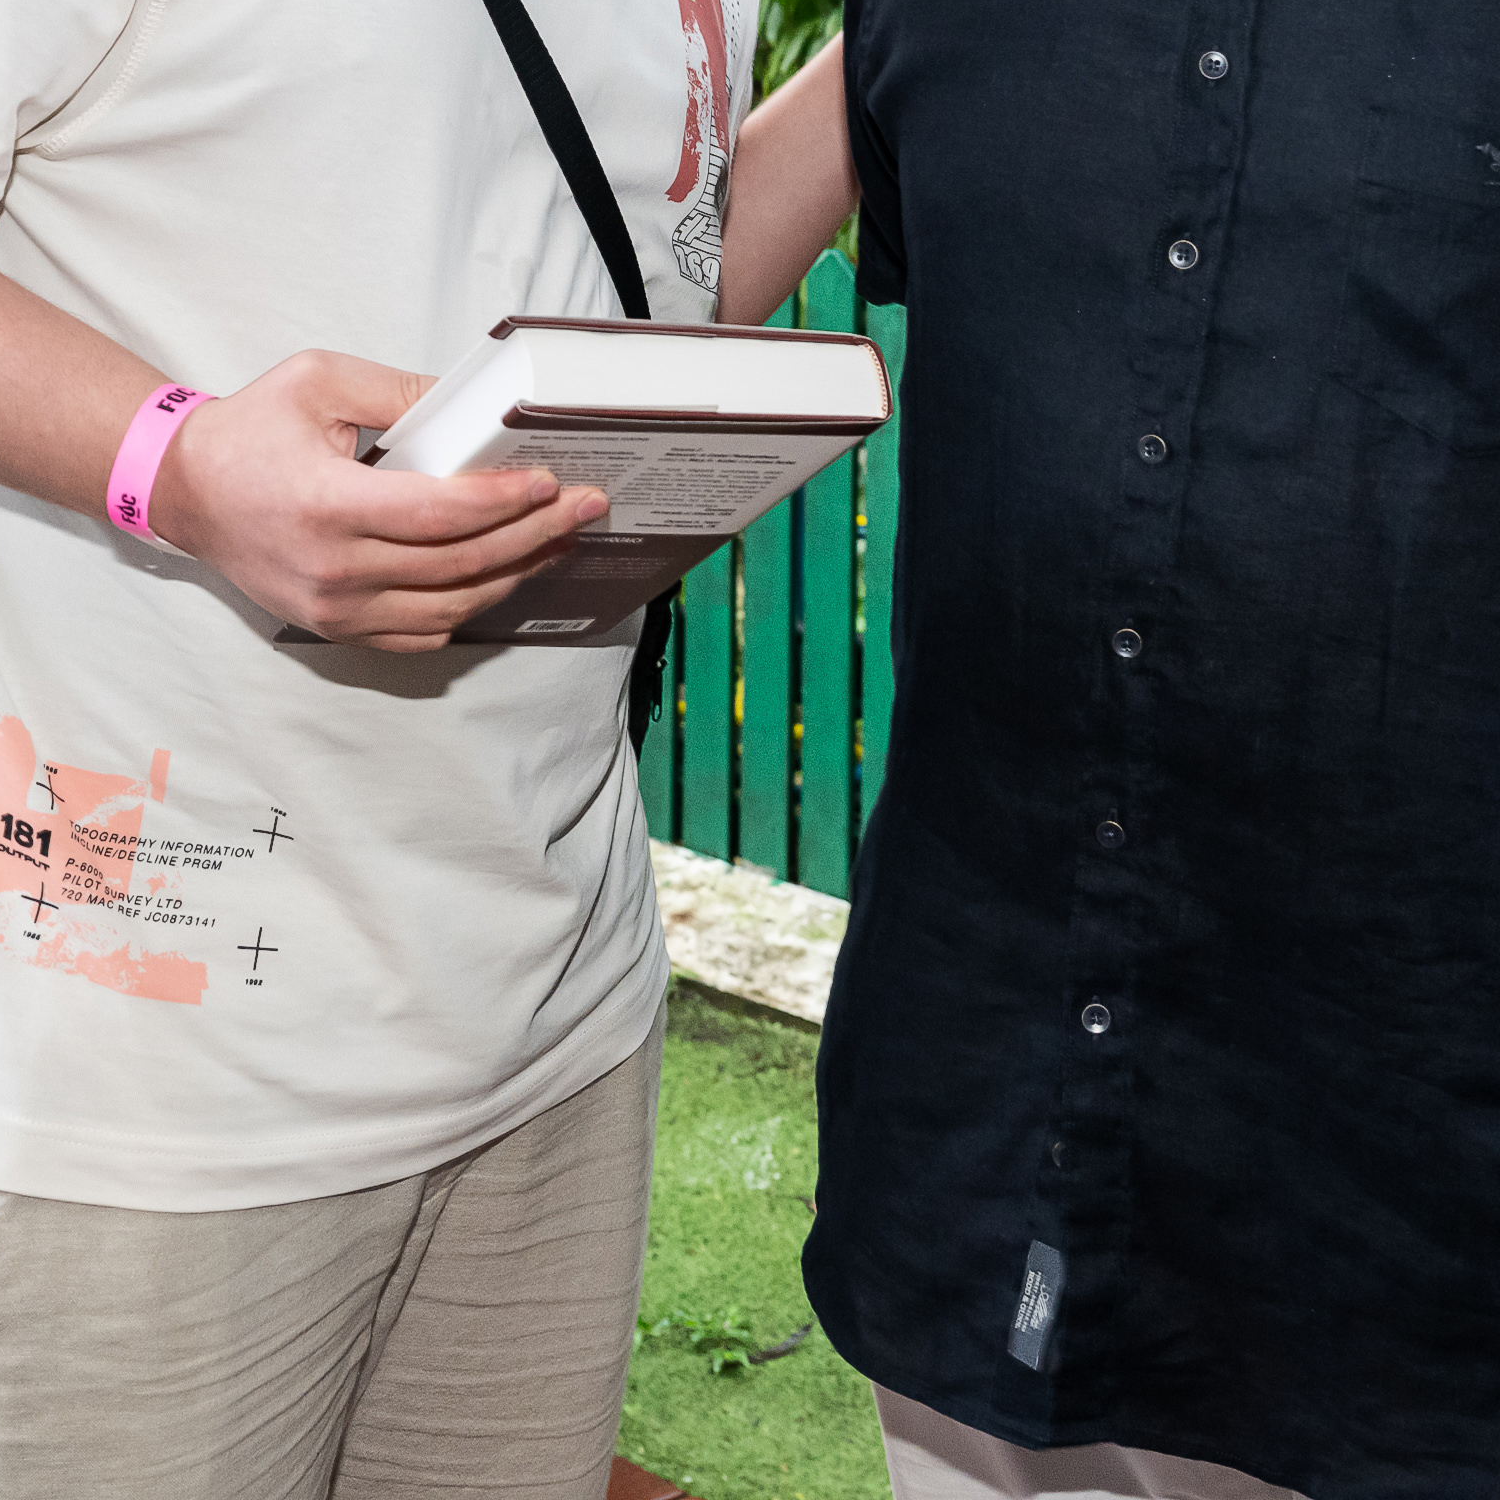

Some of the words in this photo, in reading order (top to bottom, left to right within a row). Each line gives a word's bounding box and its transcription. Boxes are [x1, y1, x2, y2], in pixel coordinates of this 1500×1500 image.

[0, 812, 52, 858] 181
[69, 819, 157, 850] TOPOGRAPHY
[161, 840, 255, 859] INFORMATION
[70, 831, 179, 867] INCLINE/DECLINE
[182, 857, 223, 871] PRGM
[64, 857, 104, 880] P-6000
[61, 872, 102, 891] PILOT
[104, 885, 153, 907] SURVEY
[157, 898, 183, 910] LTD
[61, 887, 82, 902] 720
[86, 894, 114, 910] MAC
[117, 904, 141, 919] REF
[144, 911, 217, 928] JC0873141
